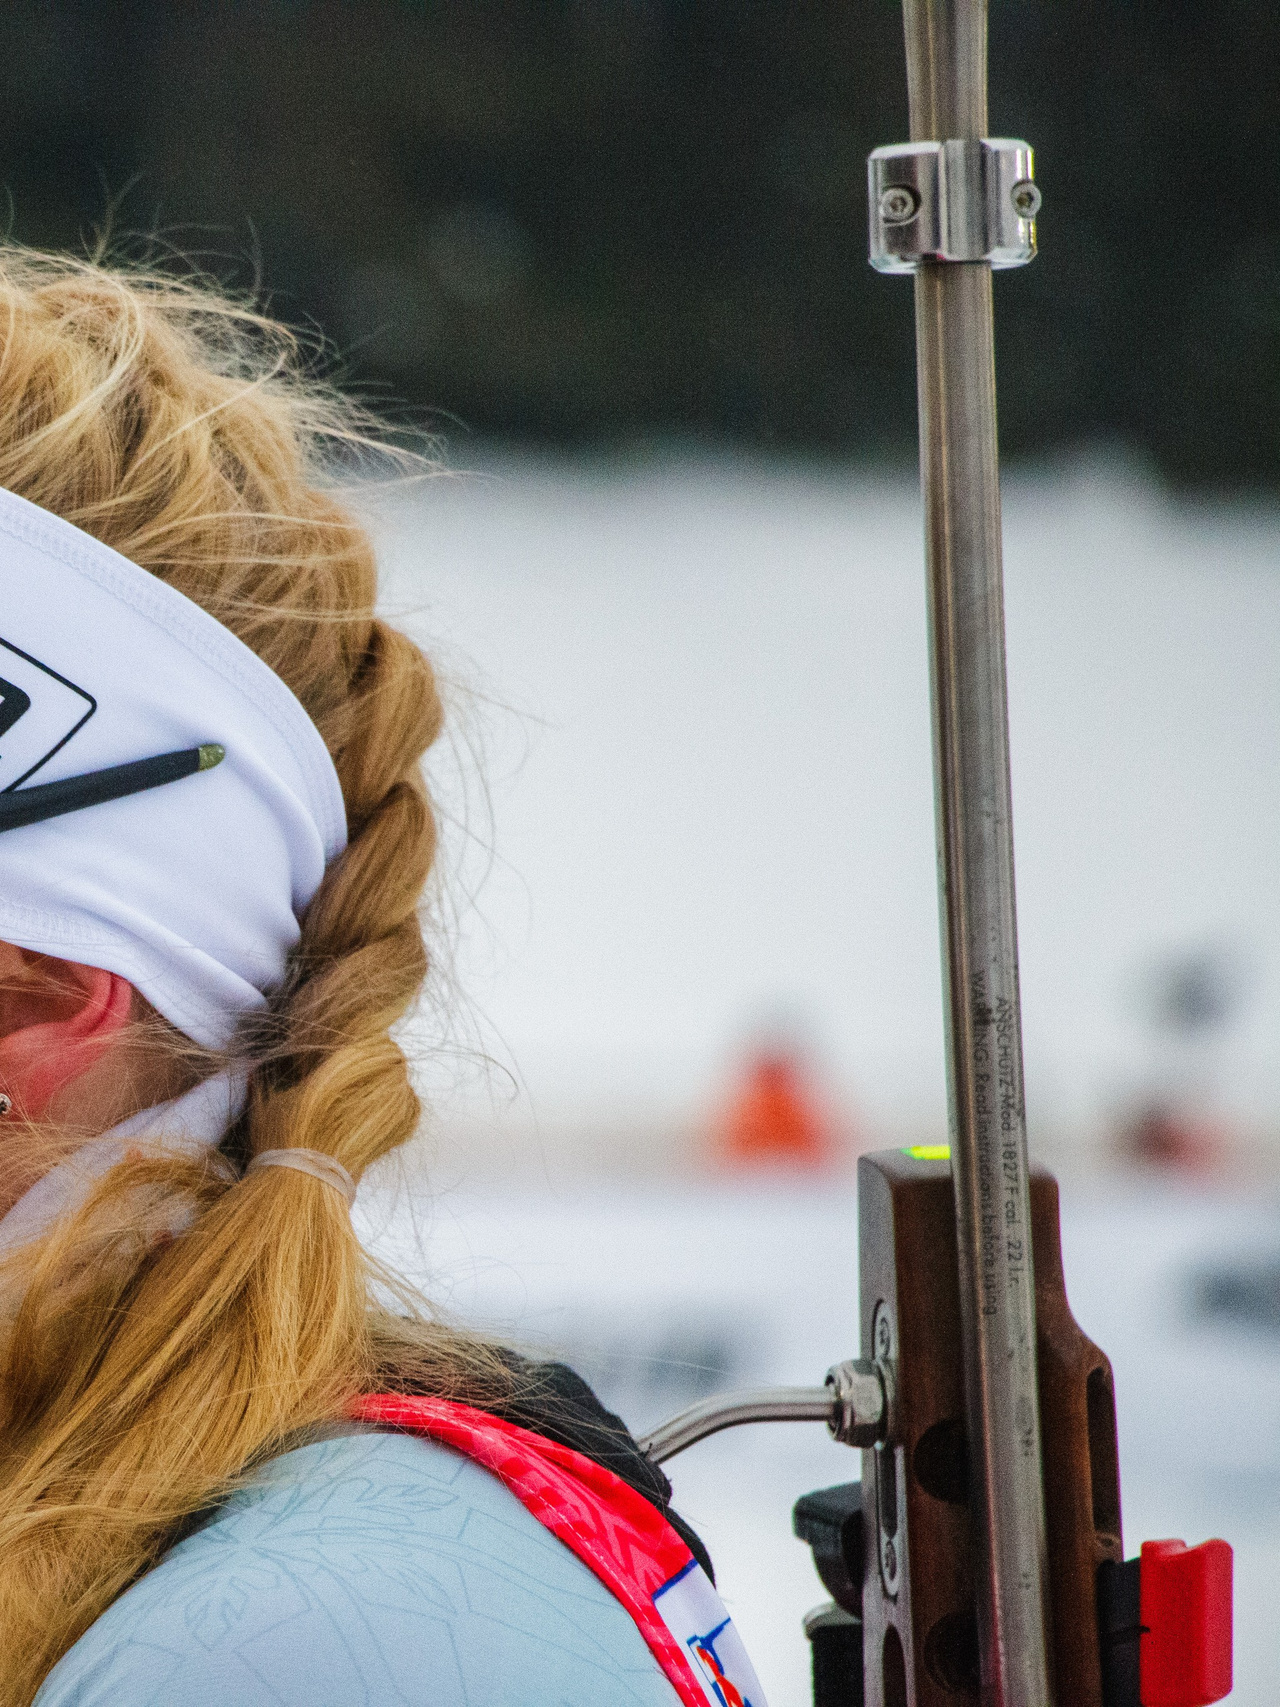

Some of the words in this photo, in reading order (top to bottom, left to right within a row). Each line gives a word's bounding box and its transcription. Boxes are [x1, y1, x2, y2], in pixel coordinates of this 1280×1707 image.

[975, 1073, 992, 1115] Read
[977, 1120, 995, 1210] instructions
[982, 1214, 1000, 1267] before
[983, 1273, 1001, 1315] using
